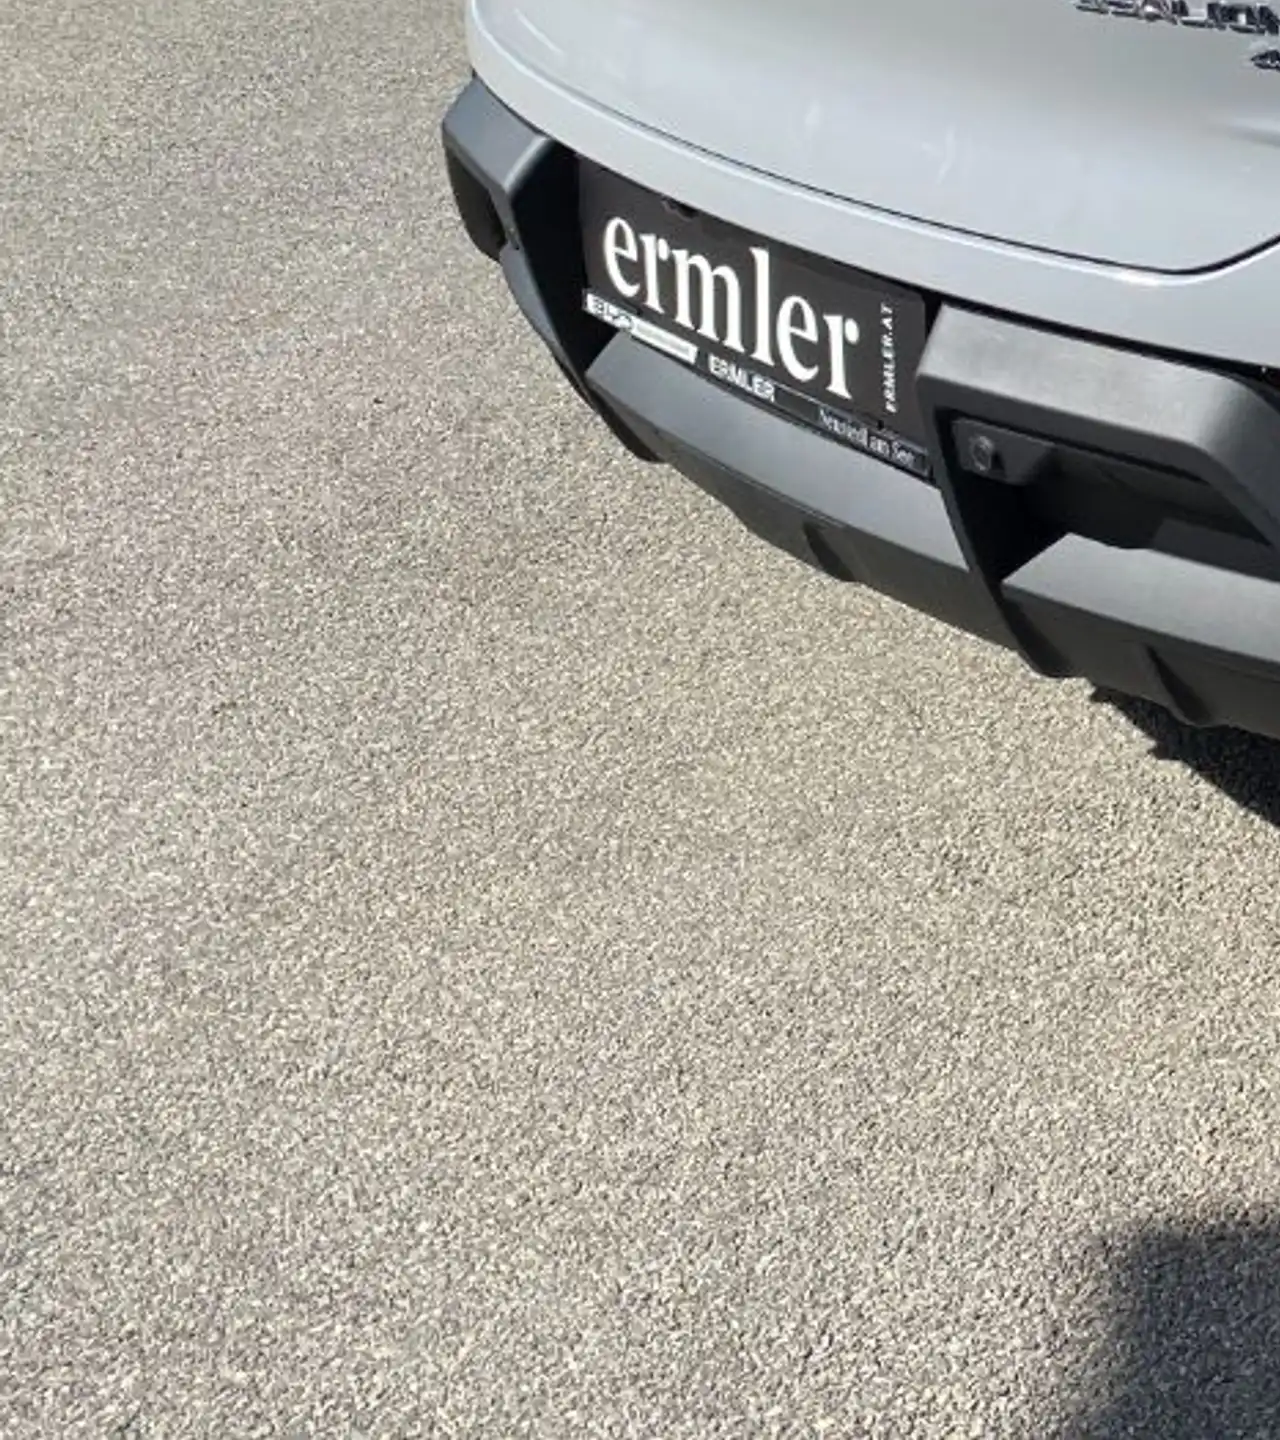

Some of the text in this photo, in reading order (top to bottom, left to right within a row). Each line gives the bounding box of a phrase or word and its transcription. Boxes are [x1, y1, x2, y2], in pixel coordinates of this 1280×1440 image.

[602, 216, 860, 400] ermler
[879, 301, 897, 413] ERMLER.AT
[708, 354, 776, 403] ERMLER
